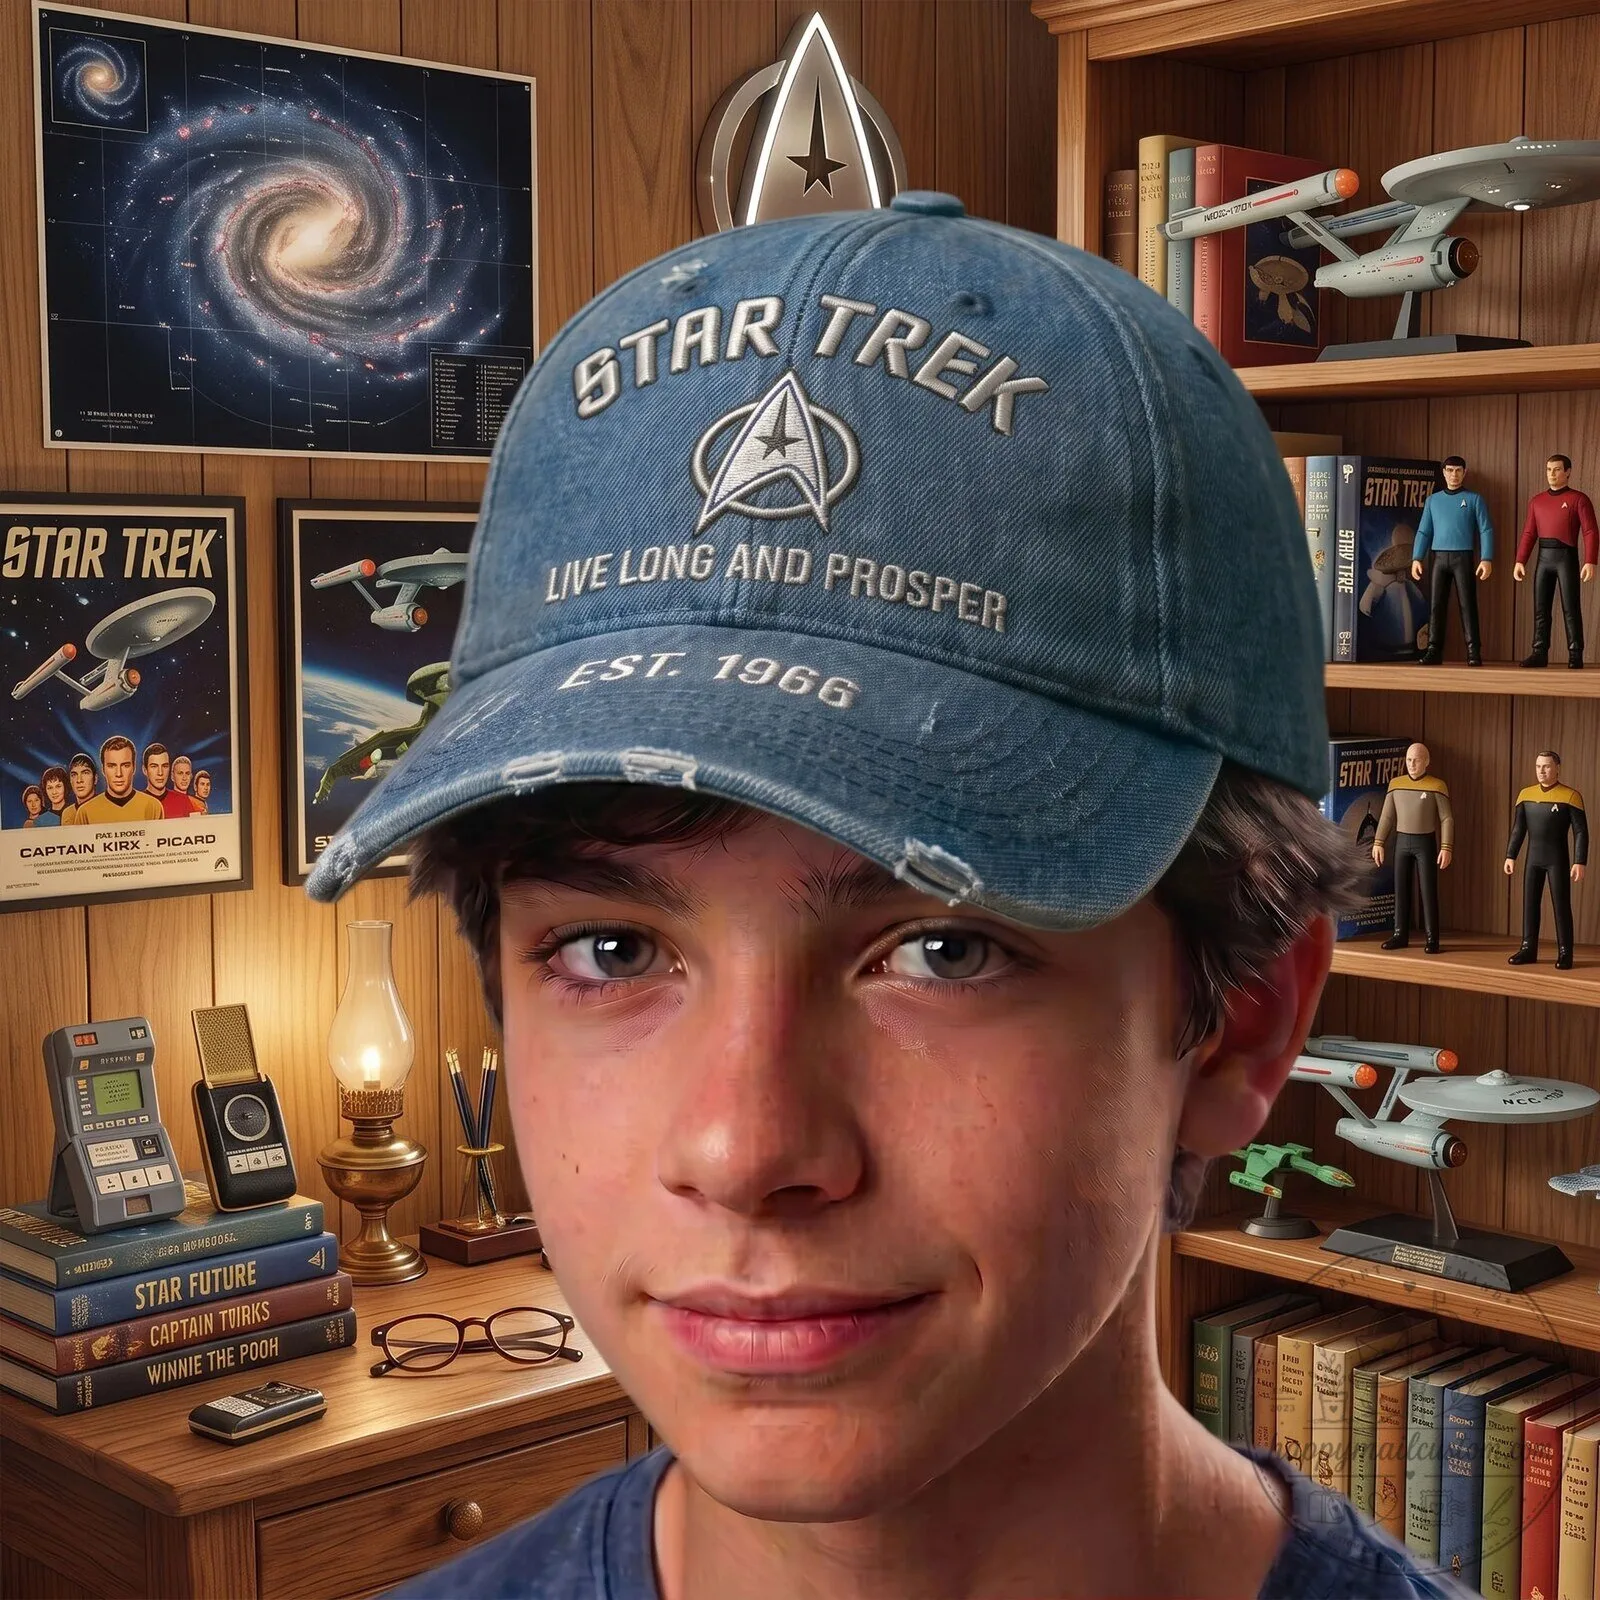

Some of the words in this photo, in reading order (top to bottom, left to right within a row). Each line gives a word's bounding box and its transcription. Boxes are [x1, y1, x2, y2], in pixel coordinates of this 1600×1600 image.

[571, 294, 785, 420] STAR
[815, 293, 1050, 437] TREK
[1364, 477, 1399, 507] STAR
[2, 526, 109, 579] STAR
[122, 527, 219, 579] TREK
[545, 552, 613, 604] LIVE
[619, 543, 716, 587] LONG
[725, 543, 813, 586] AND
[824, 552, 1009, 634] PROSPER
[556, 651, 686, 691] EST.
[1339, 760, 1373, 788] STAR
[20, 843, 95, 859] CAPTAIN
[103, 840, 140, 853] KIRX
[156, 834, 216, 848] PICARD
[135, 1276, 183, 1311] STAR
[189, 1260, 257, 1298] FUTURE
[150, 1310, 214, 1348] CAPTAIN
[146, 1355, 203, 1386] WINNIE
[206, 1347, 235, 1370] THE
[240, 1336, 280, 1364] POOH
